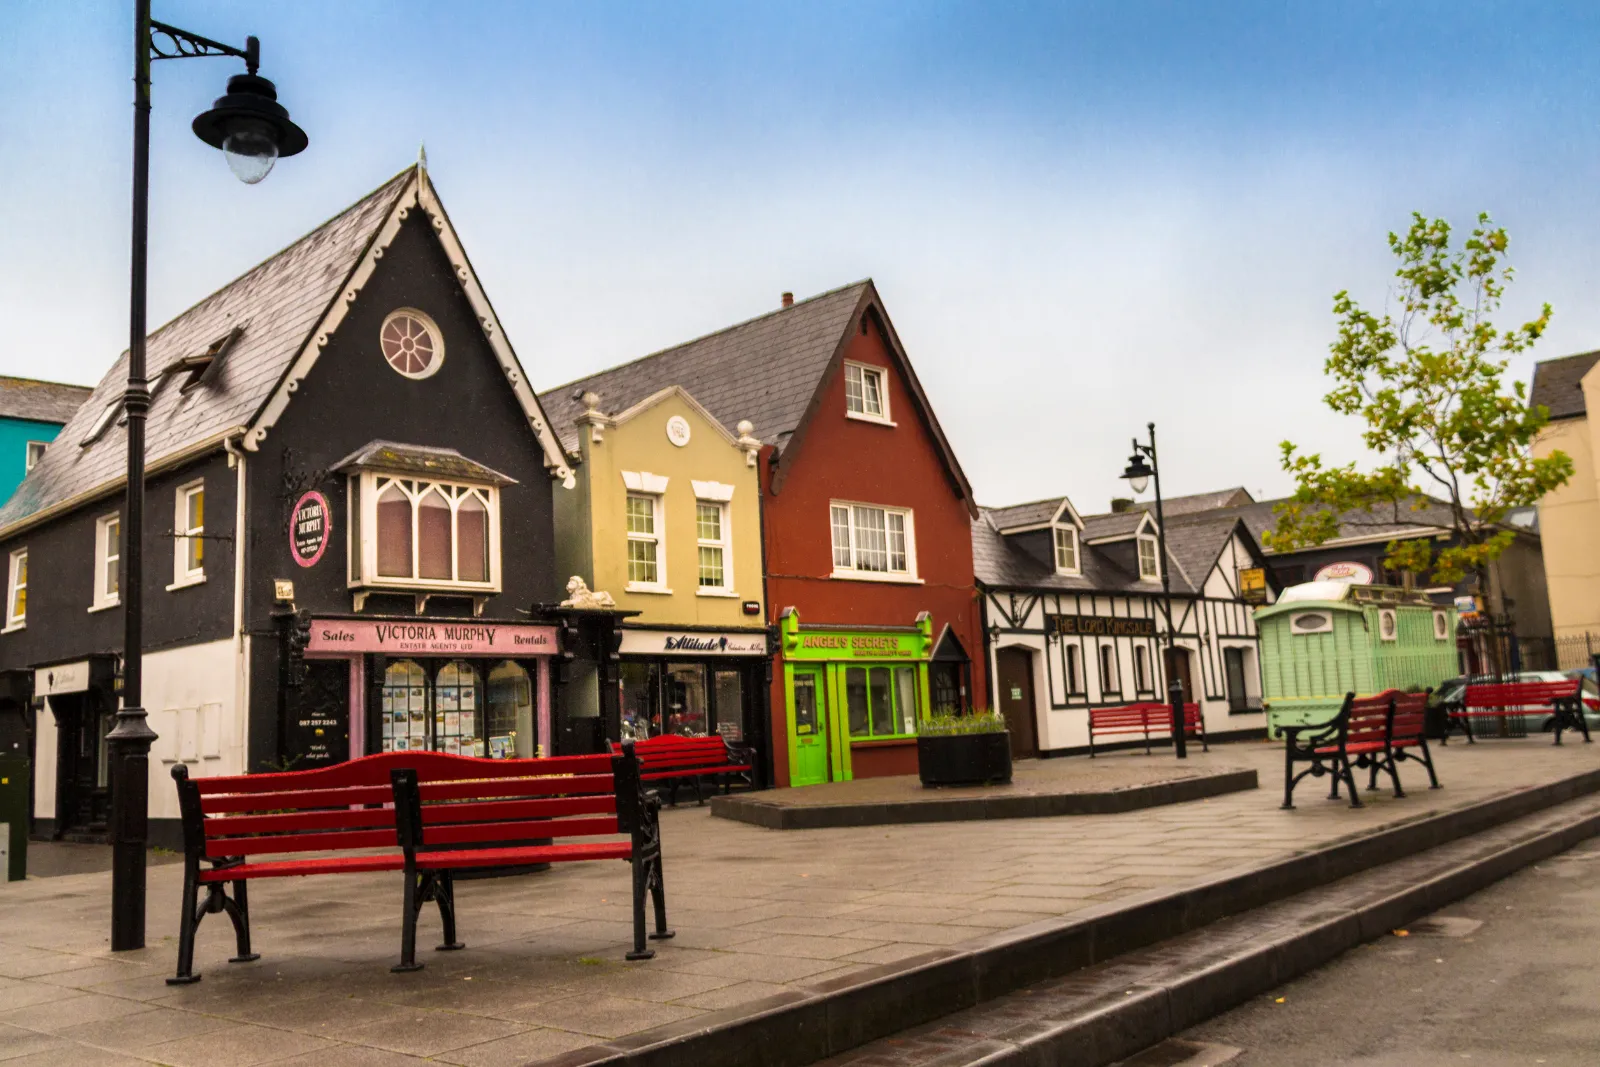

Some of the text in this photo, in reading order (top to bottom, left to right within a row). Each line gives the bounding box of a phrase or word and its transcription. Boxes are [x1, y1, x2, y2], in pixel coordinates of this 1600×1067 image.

[299, 518, 321, 535] MURPHY
[1051, 616, 1153, 635] THE LORD KINGSALE
[322, 625, 547, 645] Sales VICTORIA MURPHY Rentals
[803, 636, 899, 650] ANGEL'S SECRETS
